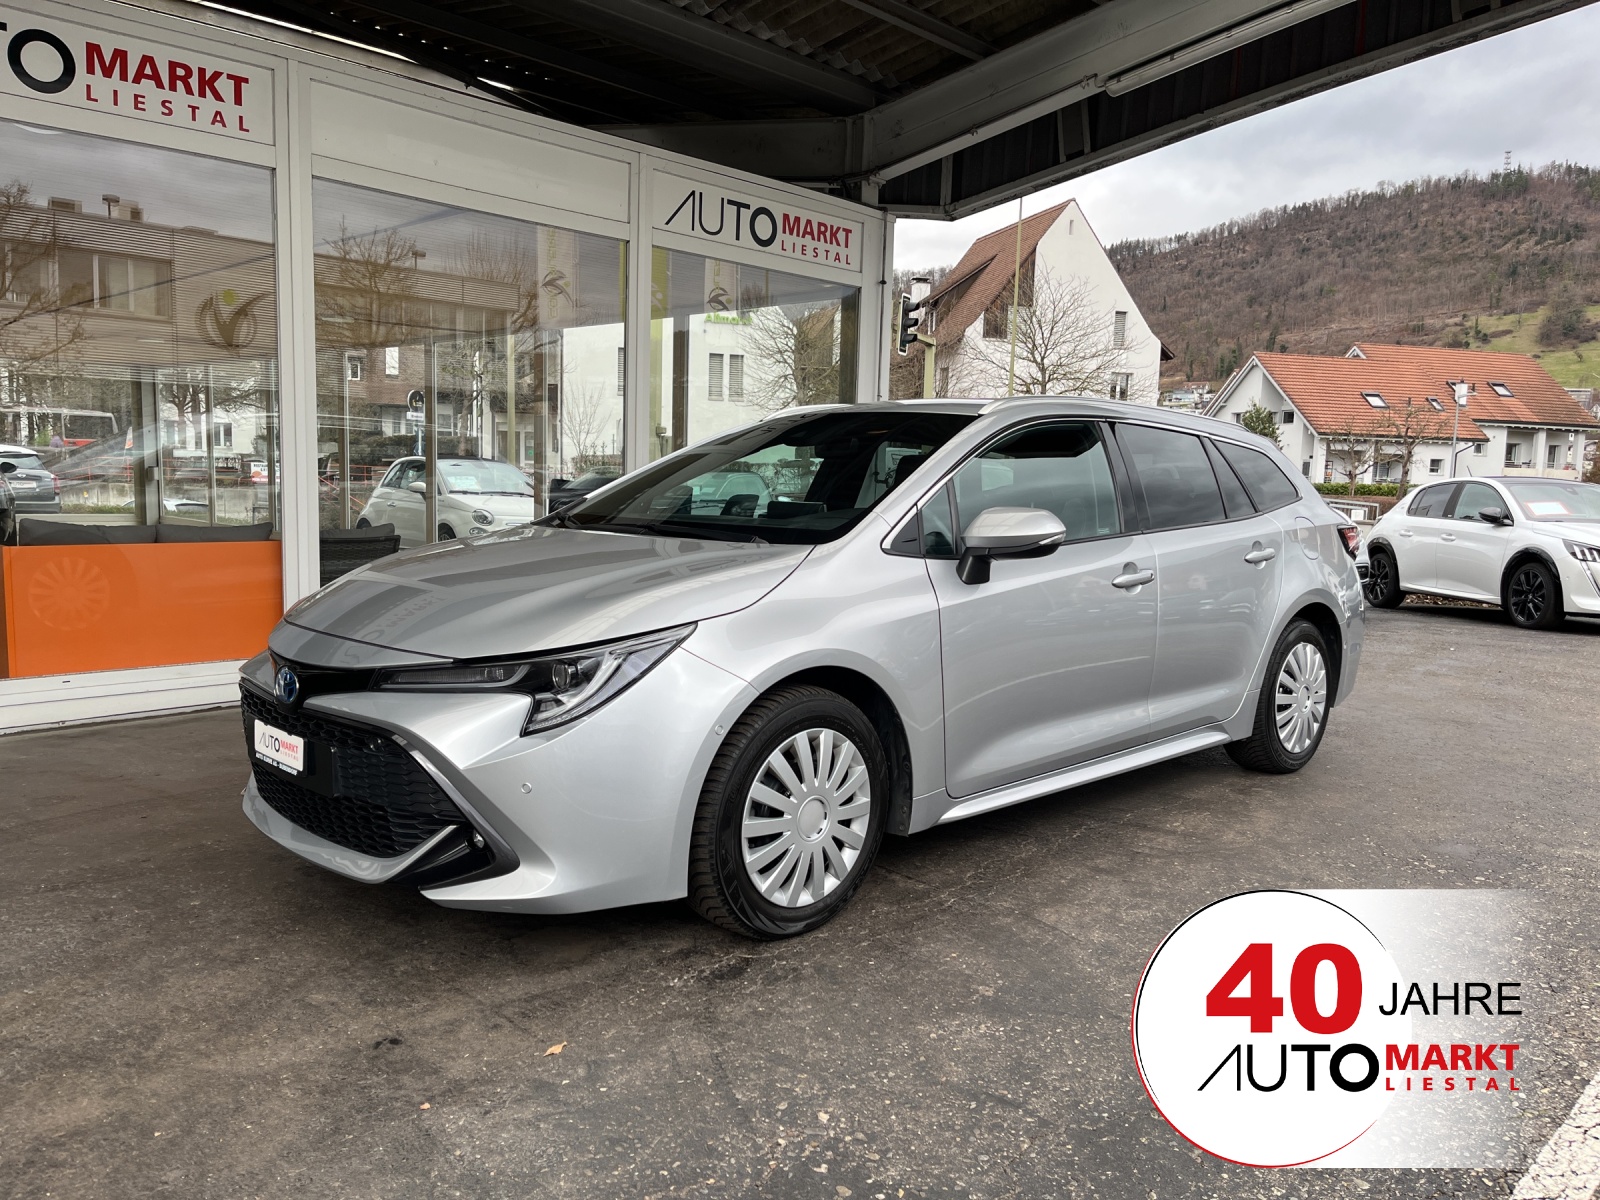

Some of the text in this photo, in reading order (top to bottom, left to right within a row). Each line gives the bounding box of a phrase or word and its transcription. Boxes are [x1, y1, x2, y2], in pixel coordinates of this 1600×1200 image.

[0, 22, 249, 107] O MARKT
[85, 84, 250, 133] LIESTAL
[664, 189, 852, 249] AUTO MARKT
[781, 239, 851, 265] LIESTAL
[259, 732, 299, 755] AUTO MARKT
